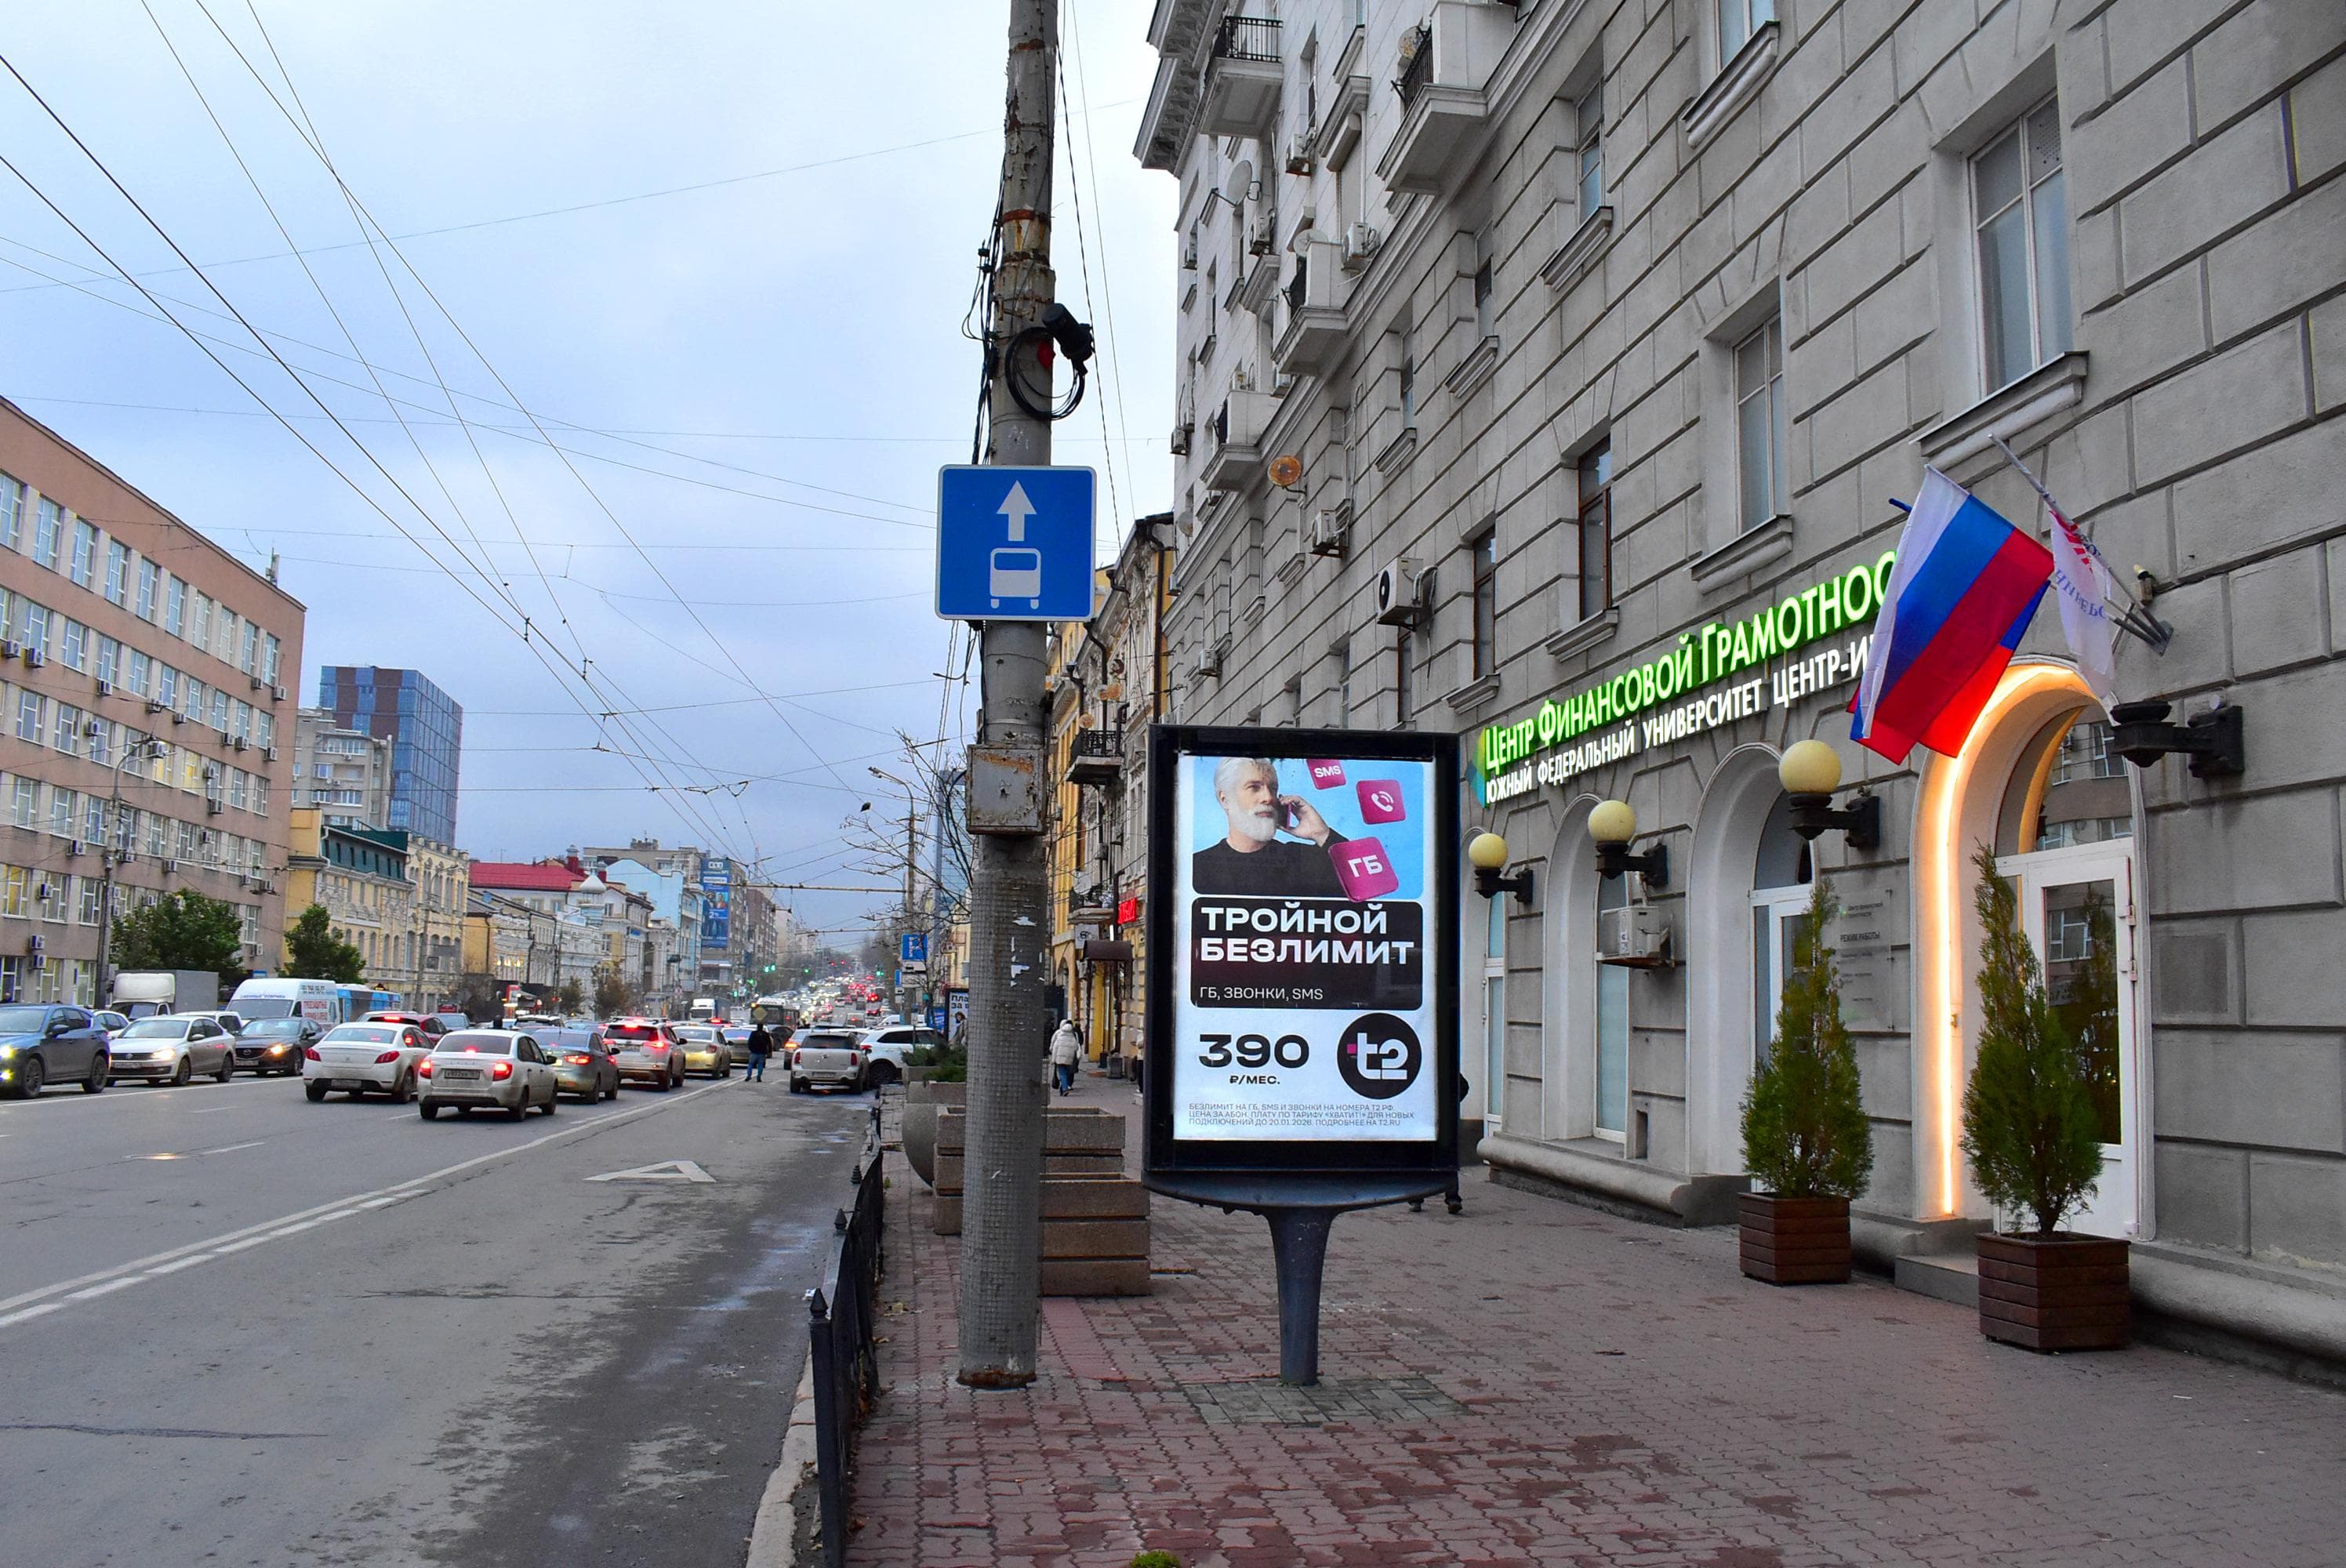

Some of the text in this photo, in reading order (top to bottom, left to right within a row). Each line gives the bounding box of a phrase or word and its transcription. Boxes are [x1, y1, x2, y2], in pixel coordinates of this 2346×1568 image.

[1486, 718, 1534, 775] ЦЕНТР
[1538, 633, 1693, 746] ФИНАНСОВОЙ
[1486, 633, 1874, 804] ЮЖНЫЙ ФЕДЕРАЛЬНЫЙ УНИВЕРСИТЕТ ЦЕНТР-И
[1314, 765, 1342, 778] SMS
[1348, 855, 1383, 877] ГБ
[1201, 902, 1387, 934] ТРОЙНОЙ
[1200, 938, 1414, 964] БЕЗЛИМИТ
[1200, 986, 1324, 1001] ГБ, ЗВОНКИ, SMS
[1198, 1033, 1309, 1069] 390
[1346, 1033, 1408, 1080] t2
[1229, 1075, 1280, 1085] ₽/МЕС.
[1189, 1117, 1255, 1126] ПОДКЛЮЧЕНИЙ
